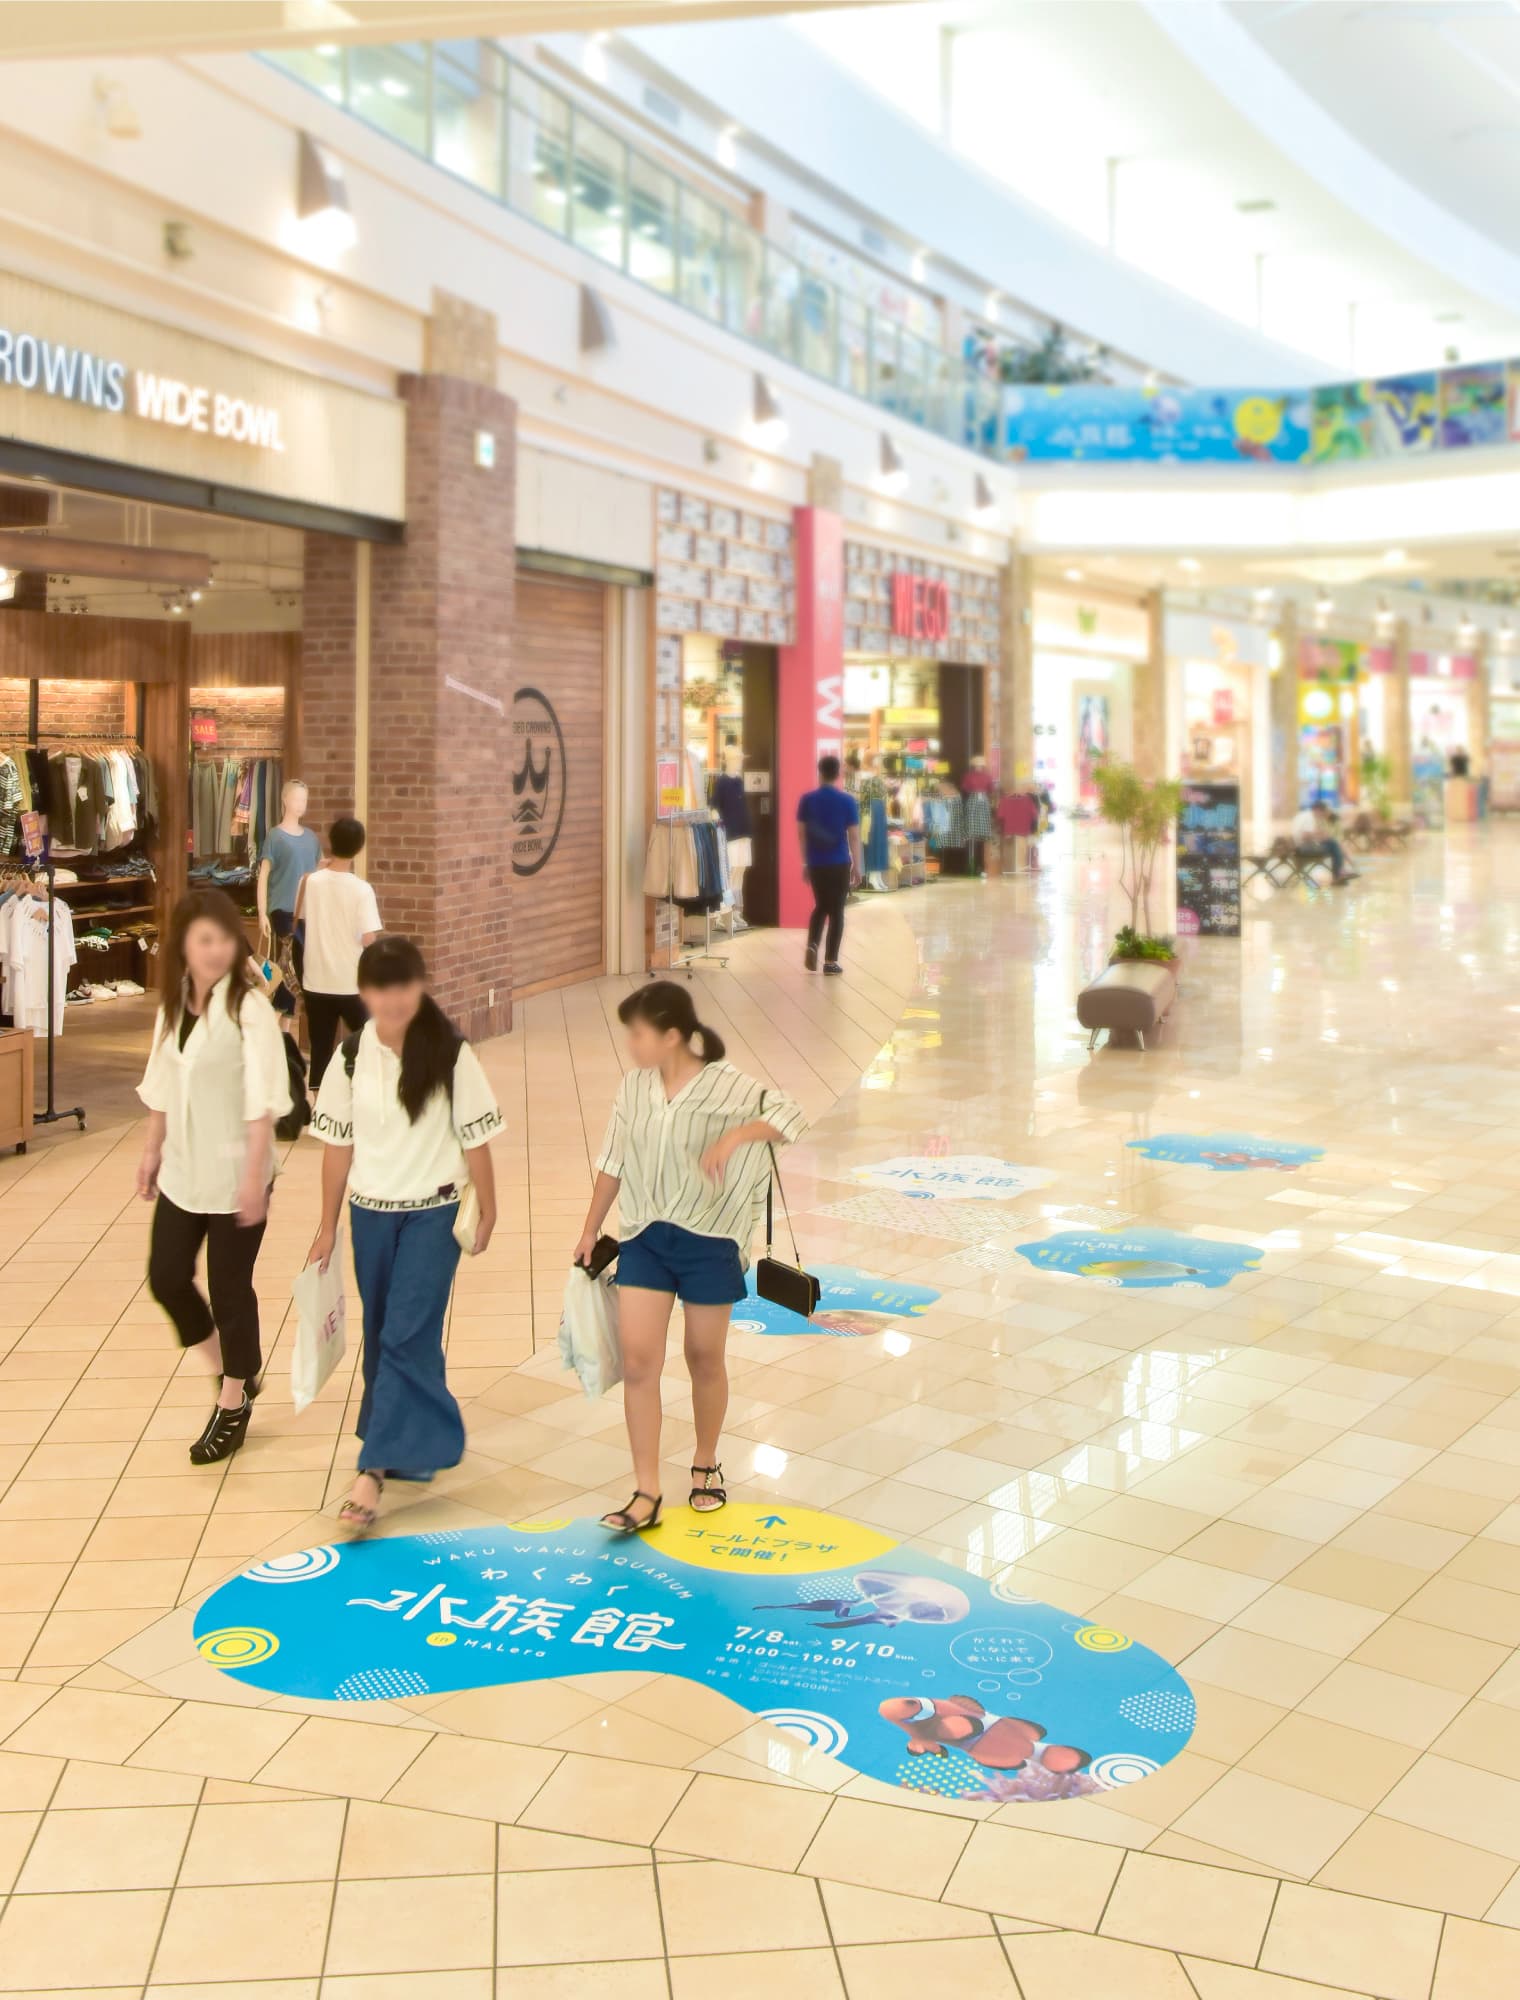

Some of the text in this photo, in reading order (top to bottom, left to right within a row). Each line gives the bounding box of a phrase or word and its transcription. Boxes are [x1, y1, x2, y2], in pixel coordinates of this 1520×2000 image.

[135, 370, 210, 432] WIDE
[212, 392, 286, 453] BOWL
[892, 572, 949, 641] WEGO
[194, 724, 216, 737] SALE
[871, 1168, 1024, 1188] 水族館
[685, 1529, 839, 1553] ゴールドプラザ
[423, 1545, 693, 1600] WAKU WAKU AQUARIUM
[480, 1567, 629, 1597] わくわく
[347, 1583, 686, 1653] 水族館
[734, 1626, 784, 1643] 7/8
[830, 1638, 895, 1658] 9/10
